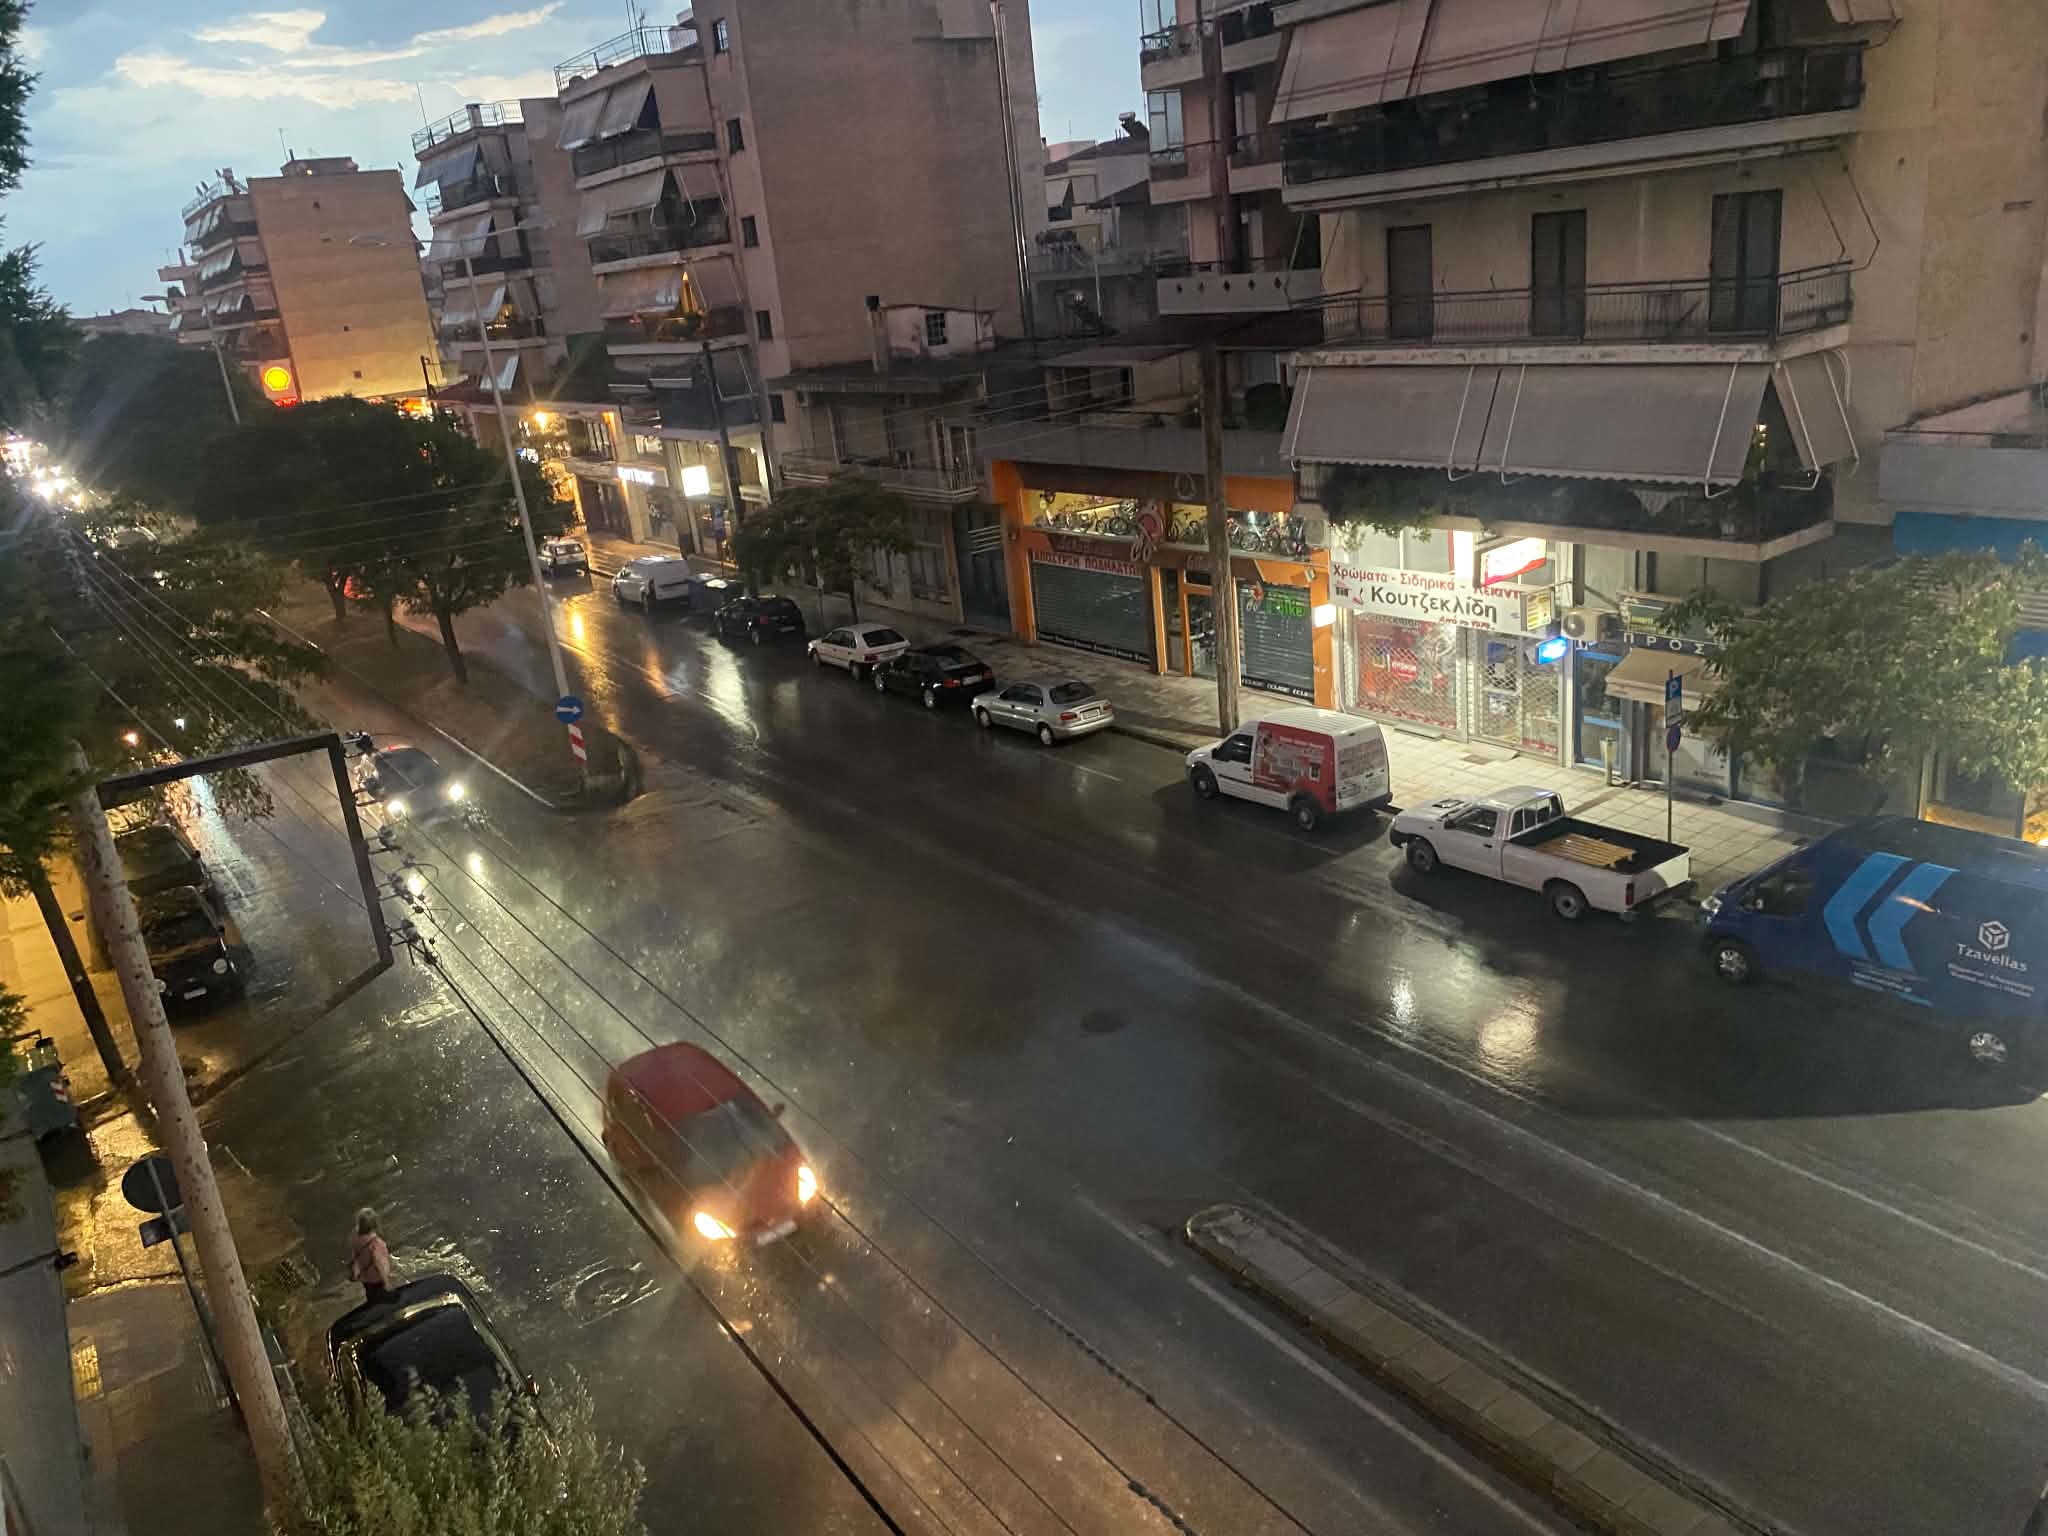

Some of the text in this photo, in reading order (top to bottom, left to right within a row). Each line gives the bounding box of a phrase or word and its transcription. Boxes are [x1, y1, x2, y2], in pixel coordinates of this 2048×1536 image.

[1333, 564, 1388, 582] Χρώματα
[1400, 571, 1455, 591] Σιδηρικά
[1371, 585, 1498, 624] Κουτζεκλίδη
[1956, 943, 2028, 972] Tzavellas
